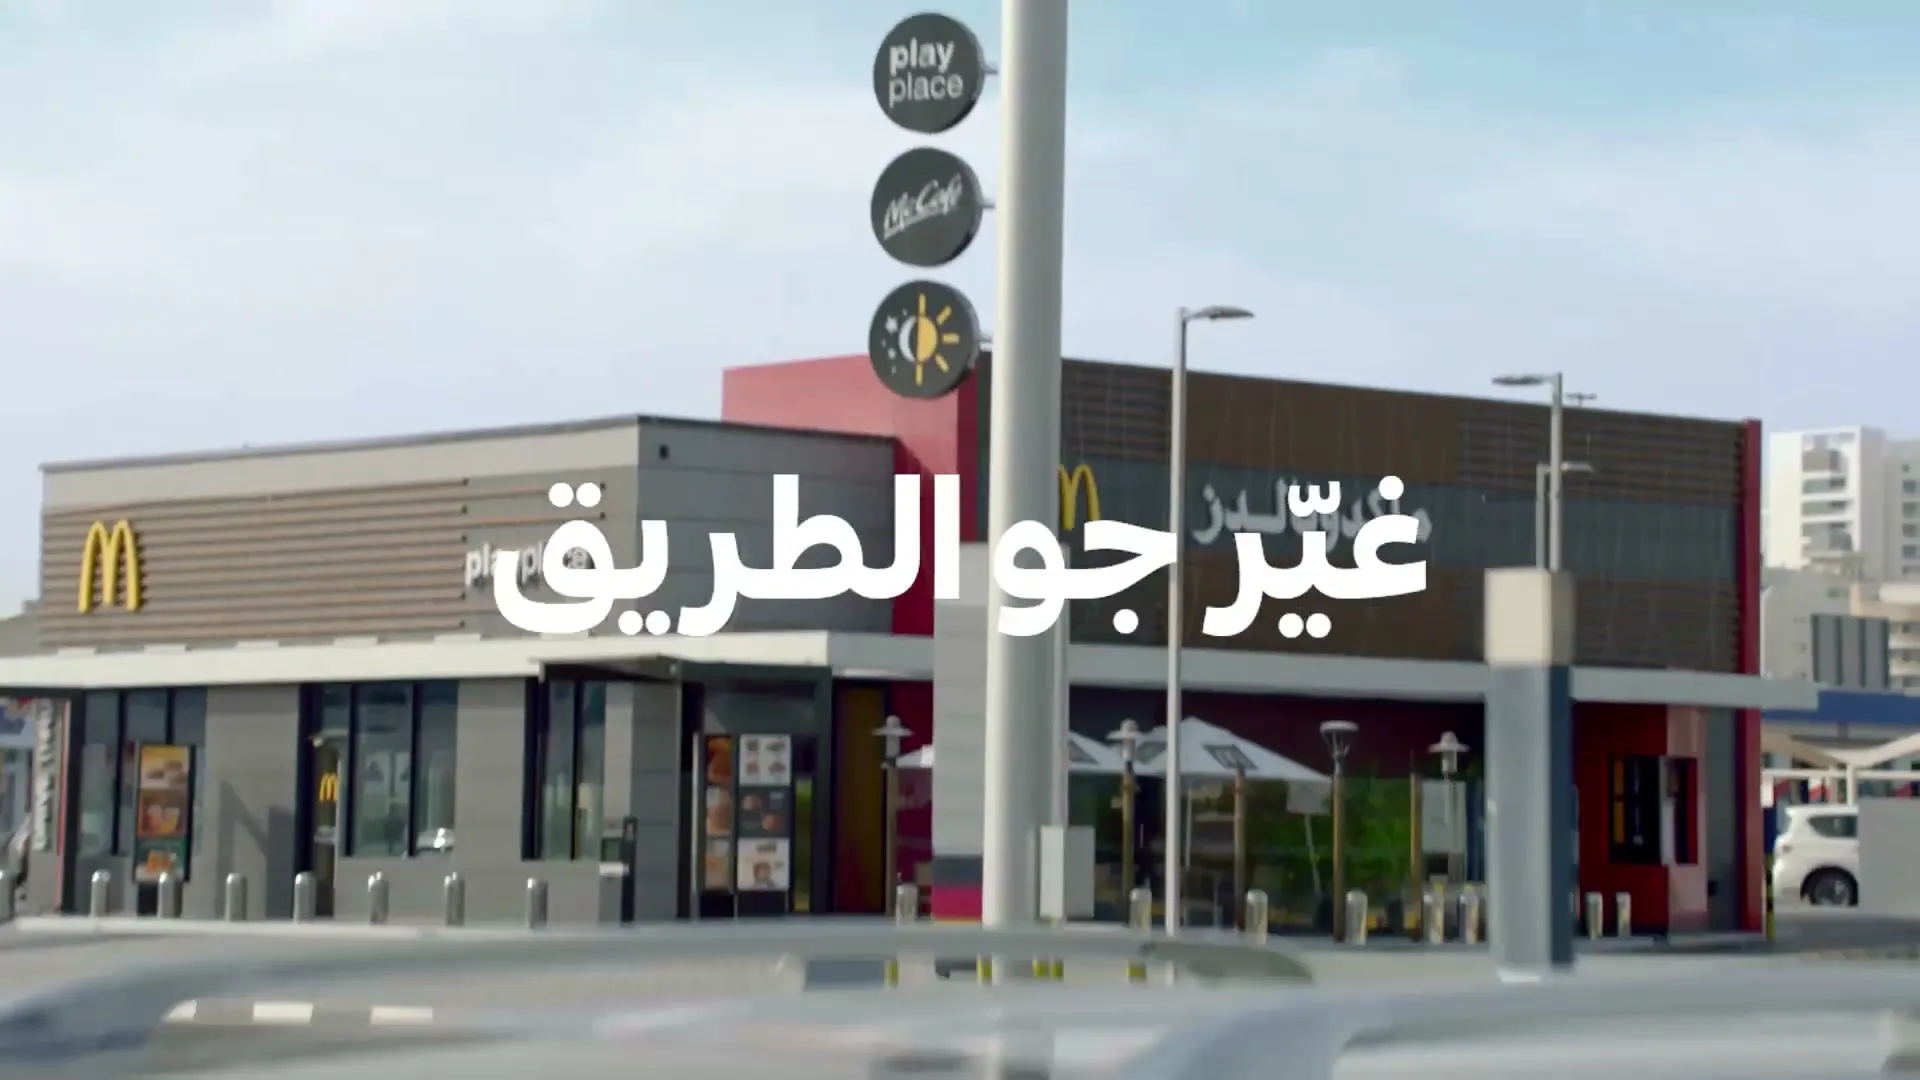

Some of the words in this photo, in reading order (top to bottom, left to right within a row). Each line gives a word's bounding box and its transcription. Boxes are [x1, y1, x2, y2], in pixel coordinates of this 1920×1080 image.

[889, 37, 955, 77] play
[888, 71, 964, 108] place
[520, 539, 588, 584] ple
